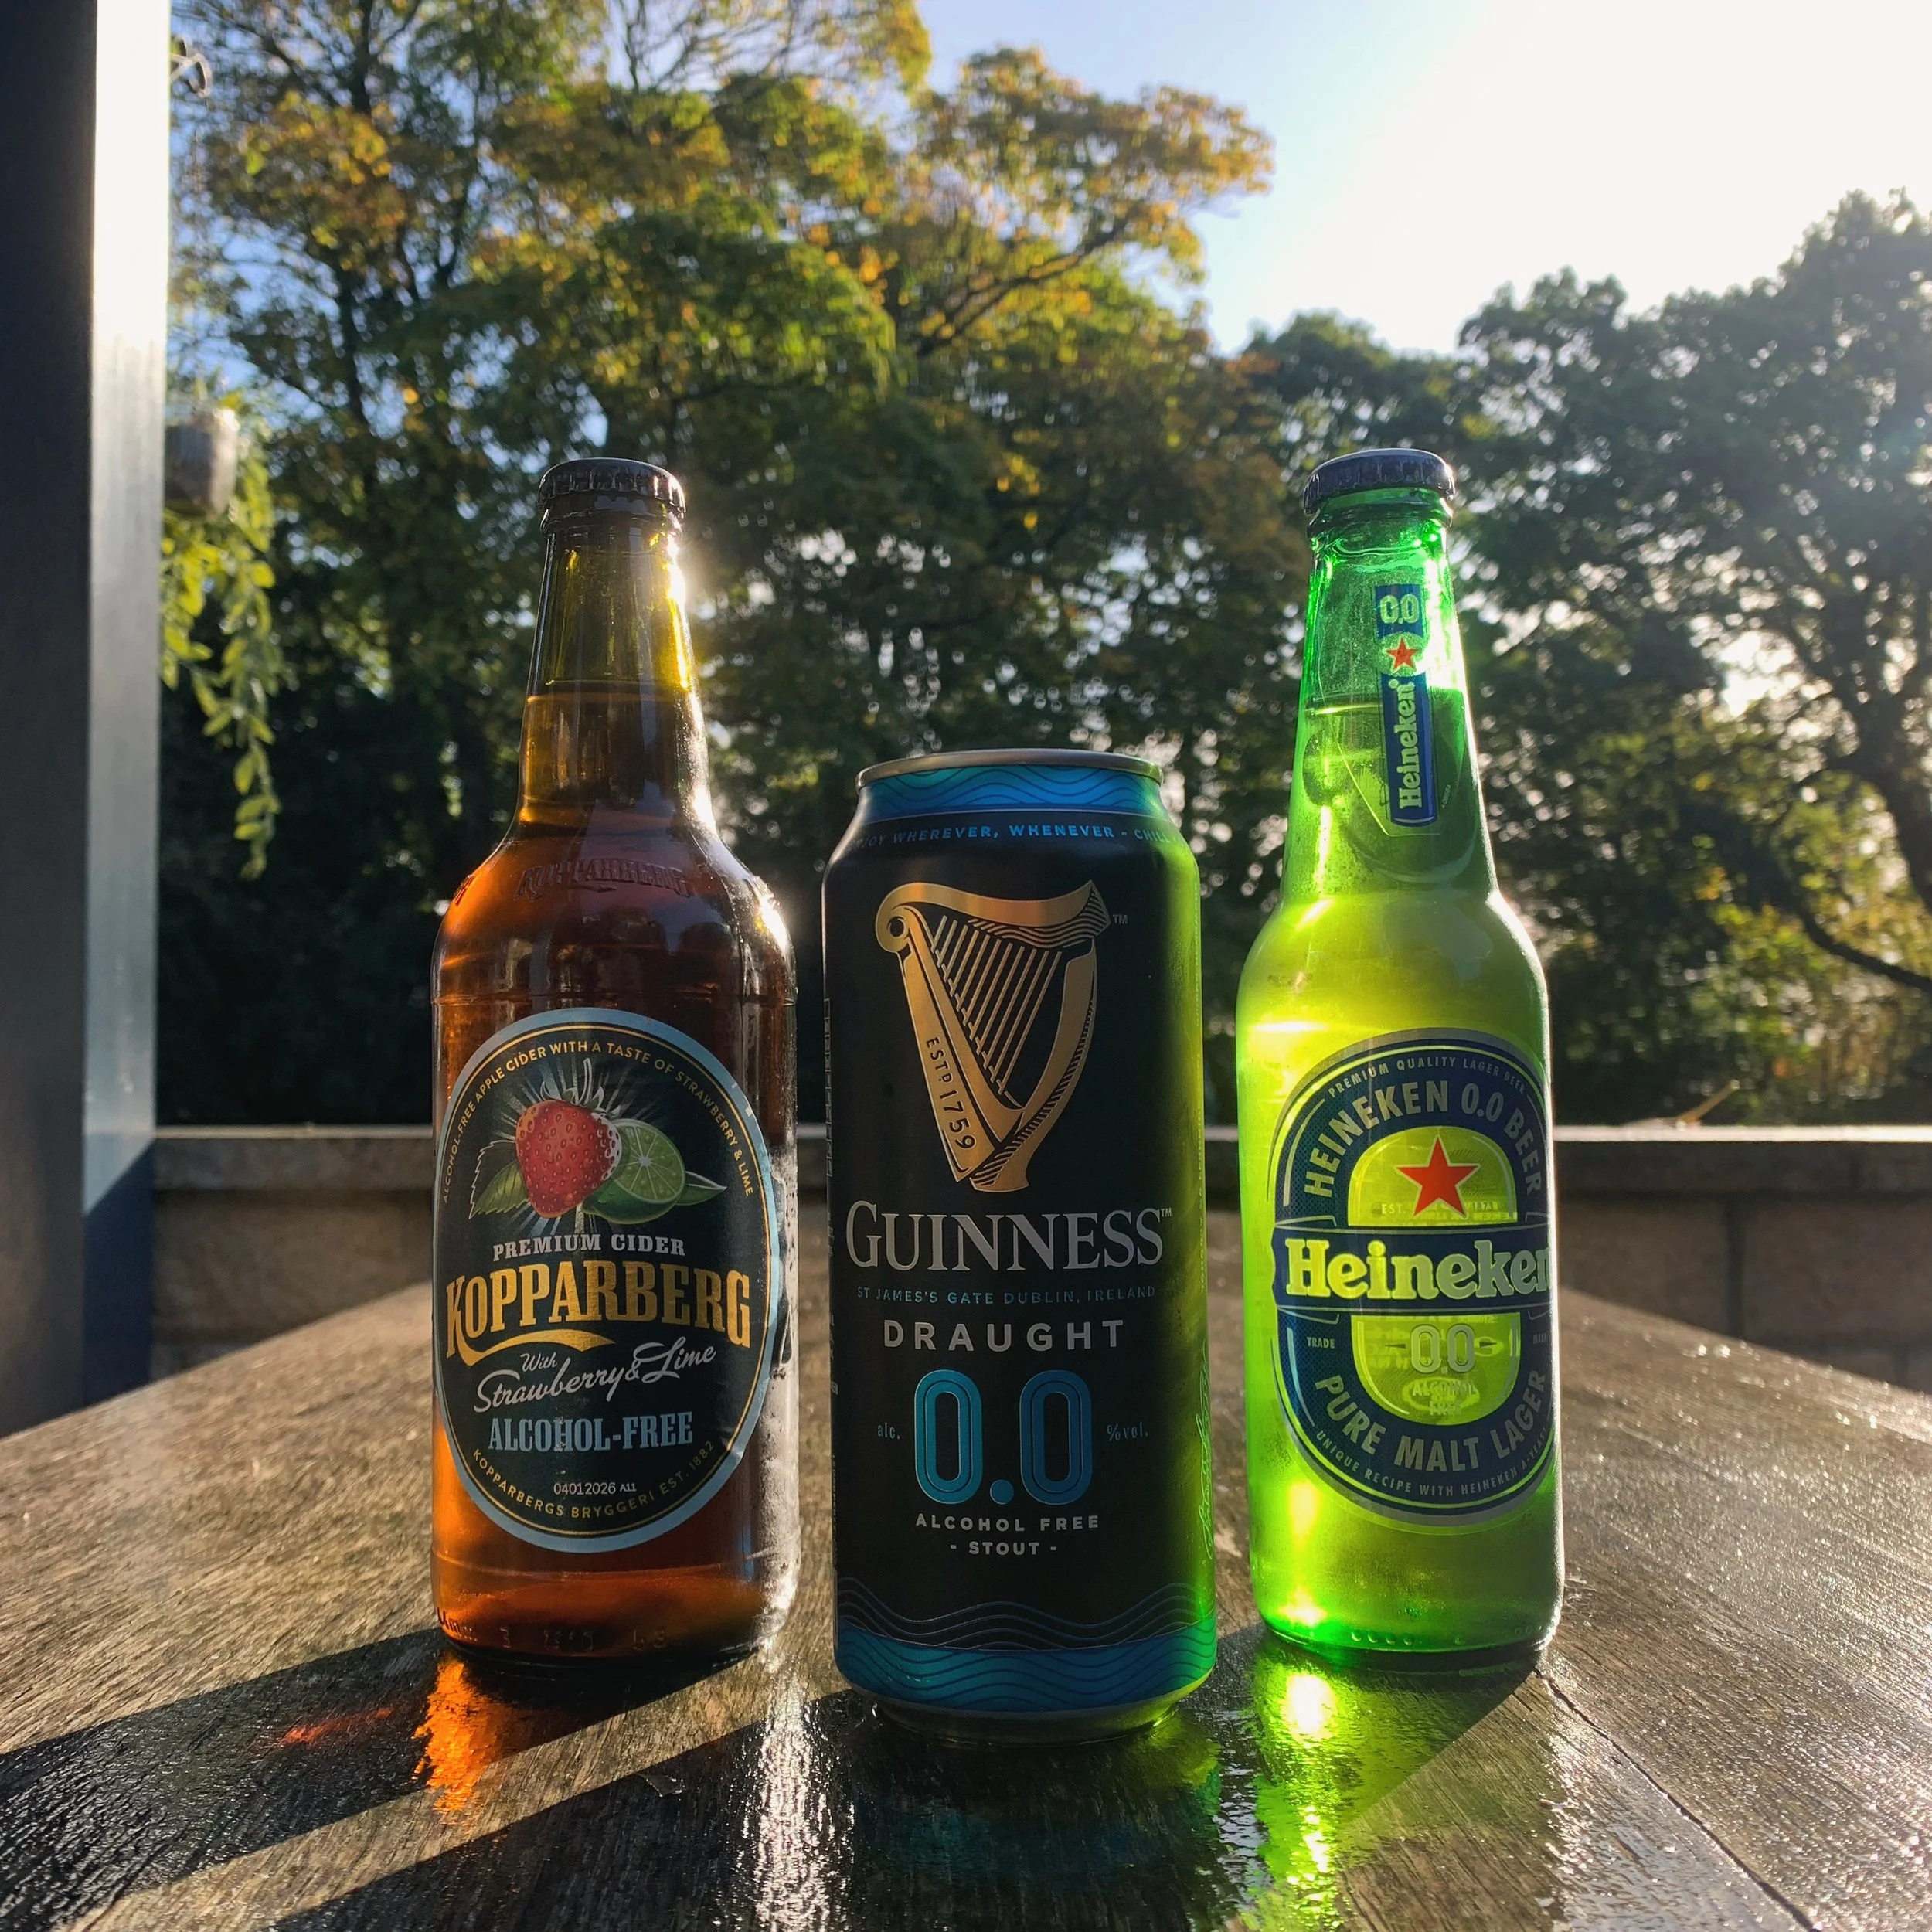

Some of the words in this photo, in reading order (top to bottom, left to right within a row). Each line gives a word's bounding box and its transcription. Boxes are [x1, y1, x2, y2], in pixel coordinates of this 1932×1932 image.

[1394, 681, 1423, 810] Heineken
[893, 825, 999, 844] WHEREVER,
[1009, 824, 1115, 838] WHENEVER
[1328, 1062, 1389, 1098] PREMIUM
[1396, 1056, 1457, 1071] QUALITY
[1463, 1058, 1500, 1077] LAGER
[1504, 1071, 1526, 1095] BEER
[444, 1100, 477, 1204] ALCOHOL-FREE
[474, 1067, 505, 1104] APPLE
[505, 1047, 546, 1072] CIDER
[549, 1041, 588, 1055] WITH
[591, 1041, 602, 1053] A
[607, 1043, 651, 1064] TASTE
[654, 1059, 675, 1073] OF
[675, 1071, 738, 1147] STRAWBERRY
[733, 1149, 743, 1162] &
[738, 1162, 753, 1197] LIME
[939, 1090, 976, 1150] 1759
[1304, 1080, 1448, 1198] HEINEKEN
[1461, 1083, 1505, 1122] 0.0
[1503, 1108, 1542, 1196] BEER
[1381, 1202, 1406, 1215] EST.
[492, 1233, 601, 1262] PREMIUM
[611, 1234, 686, 1257] CIDER
[845, 1200, 1164, 1271] GUINNESS
[446, 1260, 751, 1366] KOPPARBERG
[857, 1285, 870, 1298] ST
[876, 1287, 939, 1304] JAMES'S
[947, 1291, 995, 1305] GATE
[1087, 1284, 1157, 1303] IRELAND
[883, 1319, 1124, 1352] DRAUGHT
[1306, 1337, 1335, 1349] TRADE
[520, 1351, 560, 1373] With
[488, 1411, 694, 1453] ALCOHOL-FREE
[876, 1422, 901, 1440] alc.
[913, 1369, 1094, 1505] 0.0
[1315, 1374, 1386, 1456] PURE
[1394, 1436, 1480, 1472] MALT
[1490, 1370, 1546, 1460] LAGER
[473, 1448, 564, 1516] KOPPARBERGS
[571, 1491, 655, 1519] BRYGGERI
[659, 1470, 690, 1495] EST.
[689, 1440, 714, 1470] 1882
[1316, 1430, 1360, 1472] UNIQUE
[1364, 1468, 1412, 1493] RECIPE
[1419, 1483, 1454, 1496] WITH
[1461, 1466, 1518, 1496] HEINEKEN
[553, 1481, 617, 1496] 04012026
[916, 1512, 1026, 1532] ALCOHOL
[1039, 1515, 1099, 1532] FREE
[968, 1541, 1040, 1556] STOUT
